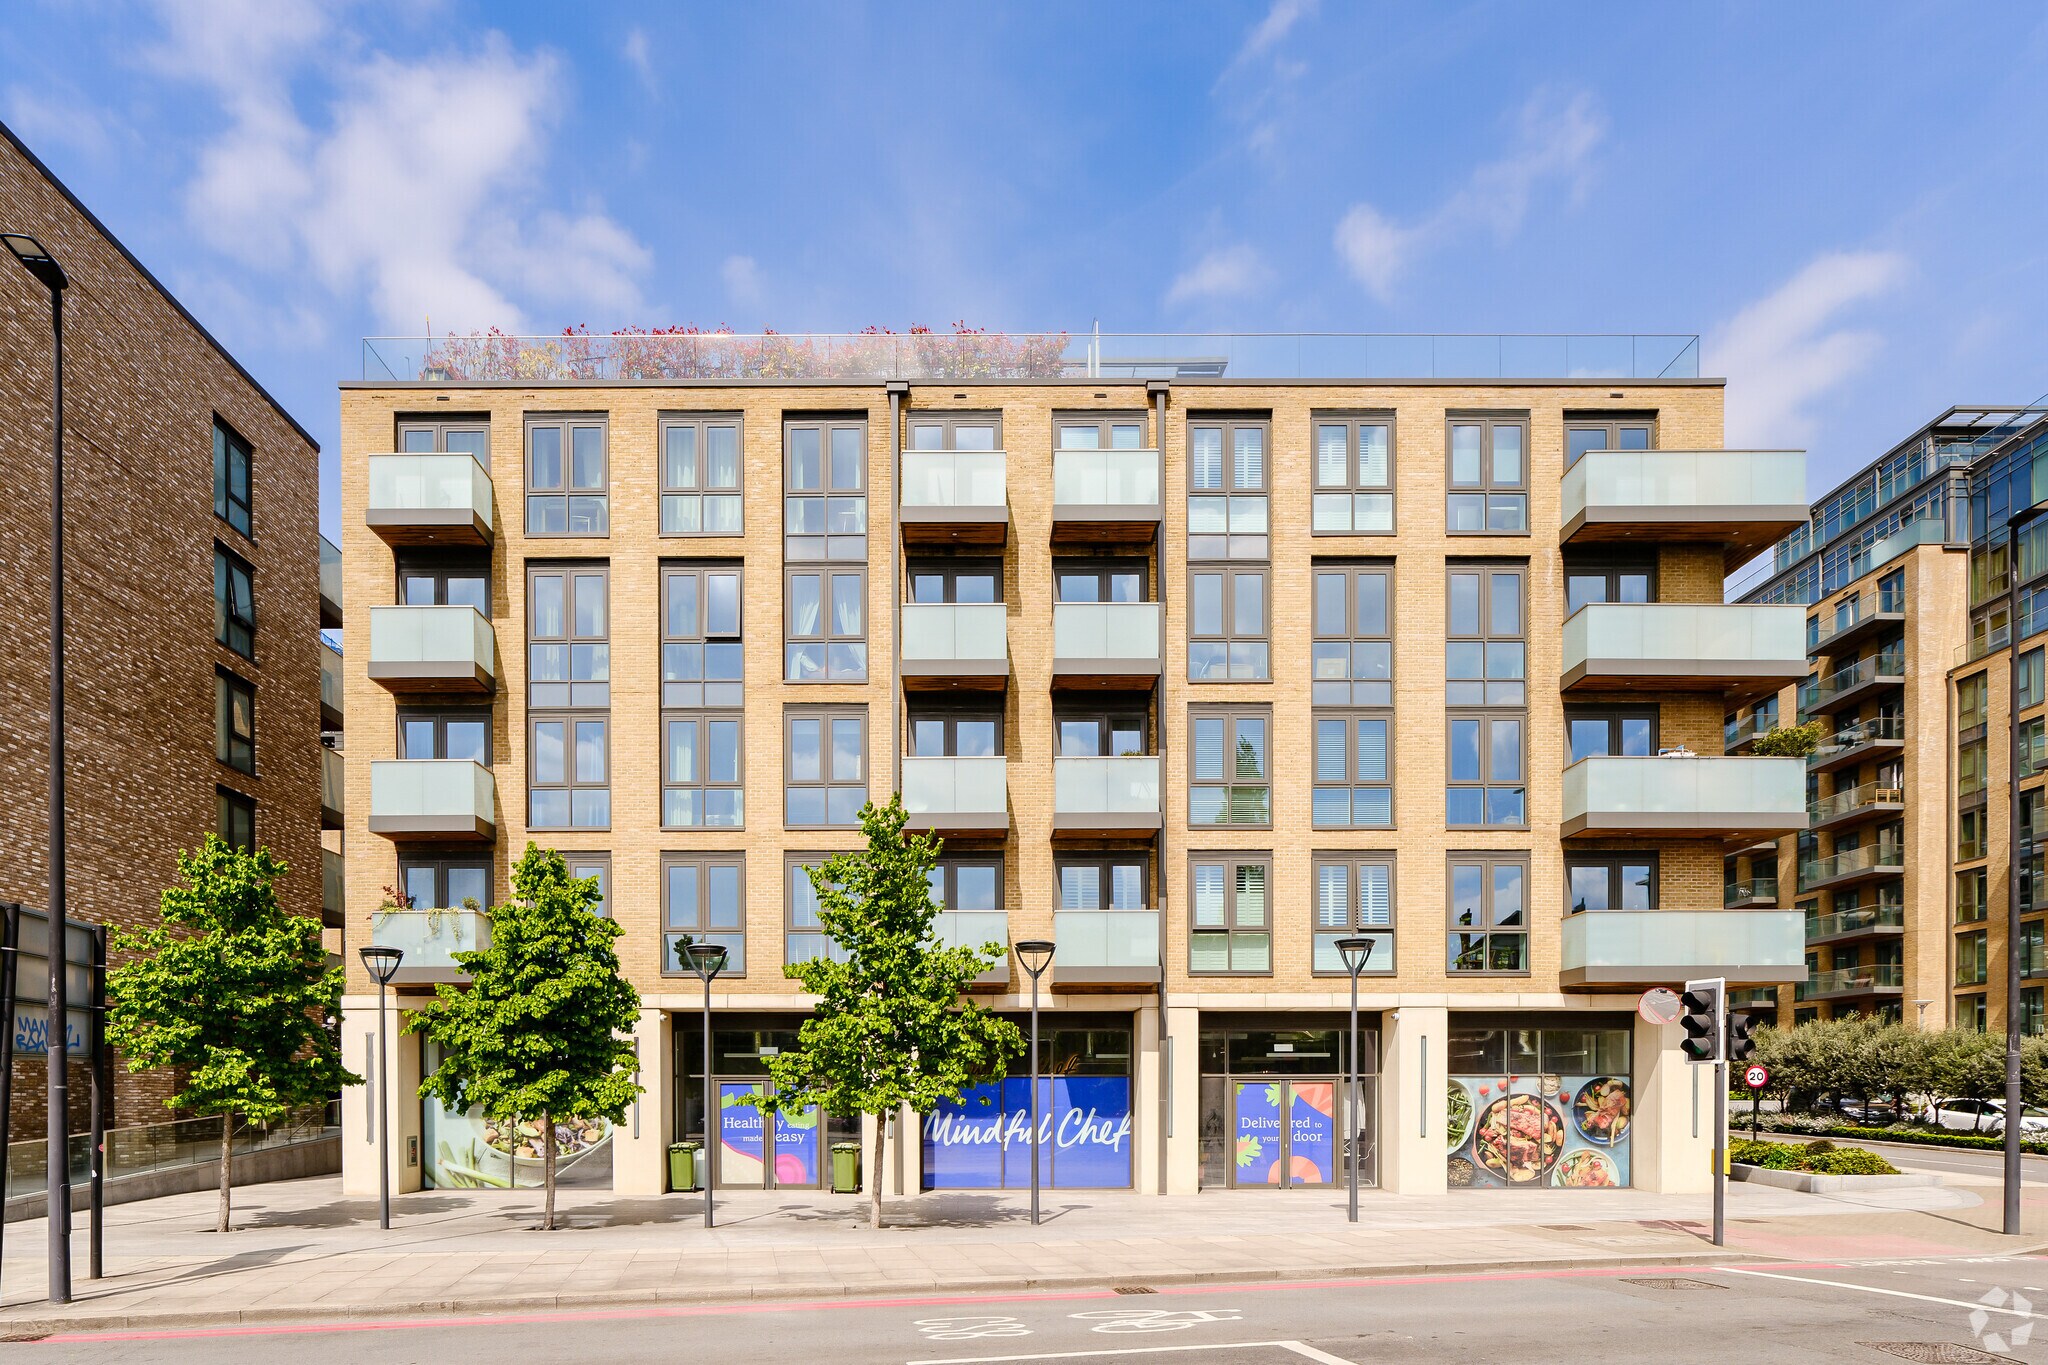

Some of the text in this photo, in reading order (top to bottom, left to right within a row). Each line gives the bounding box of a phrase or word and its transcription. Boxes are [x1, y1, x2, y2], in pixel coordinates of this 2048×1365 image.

[1749, 1072, 1764, 1081] 20
[724, 1117, 810, 1131] Healthy eating
[1241, 1117, 1310, 1128] Delivered
[923, 1107, 1130, 1152] Mindful Chef
[742, 1133, 805, 1144] made easy
[1293, 1130, 1322, 1141] door
